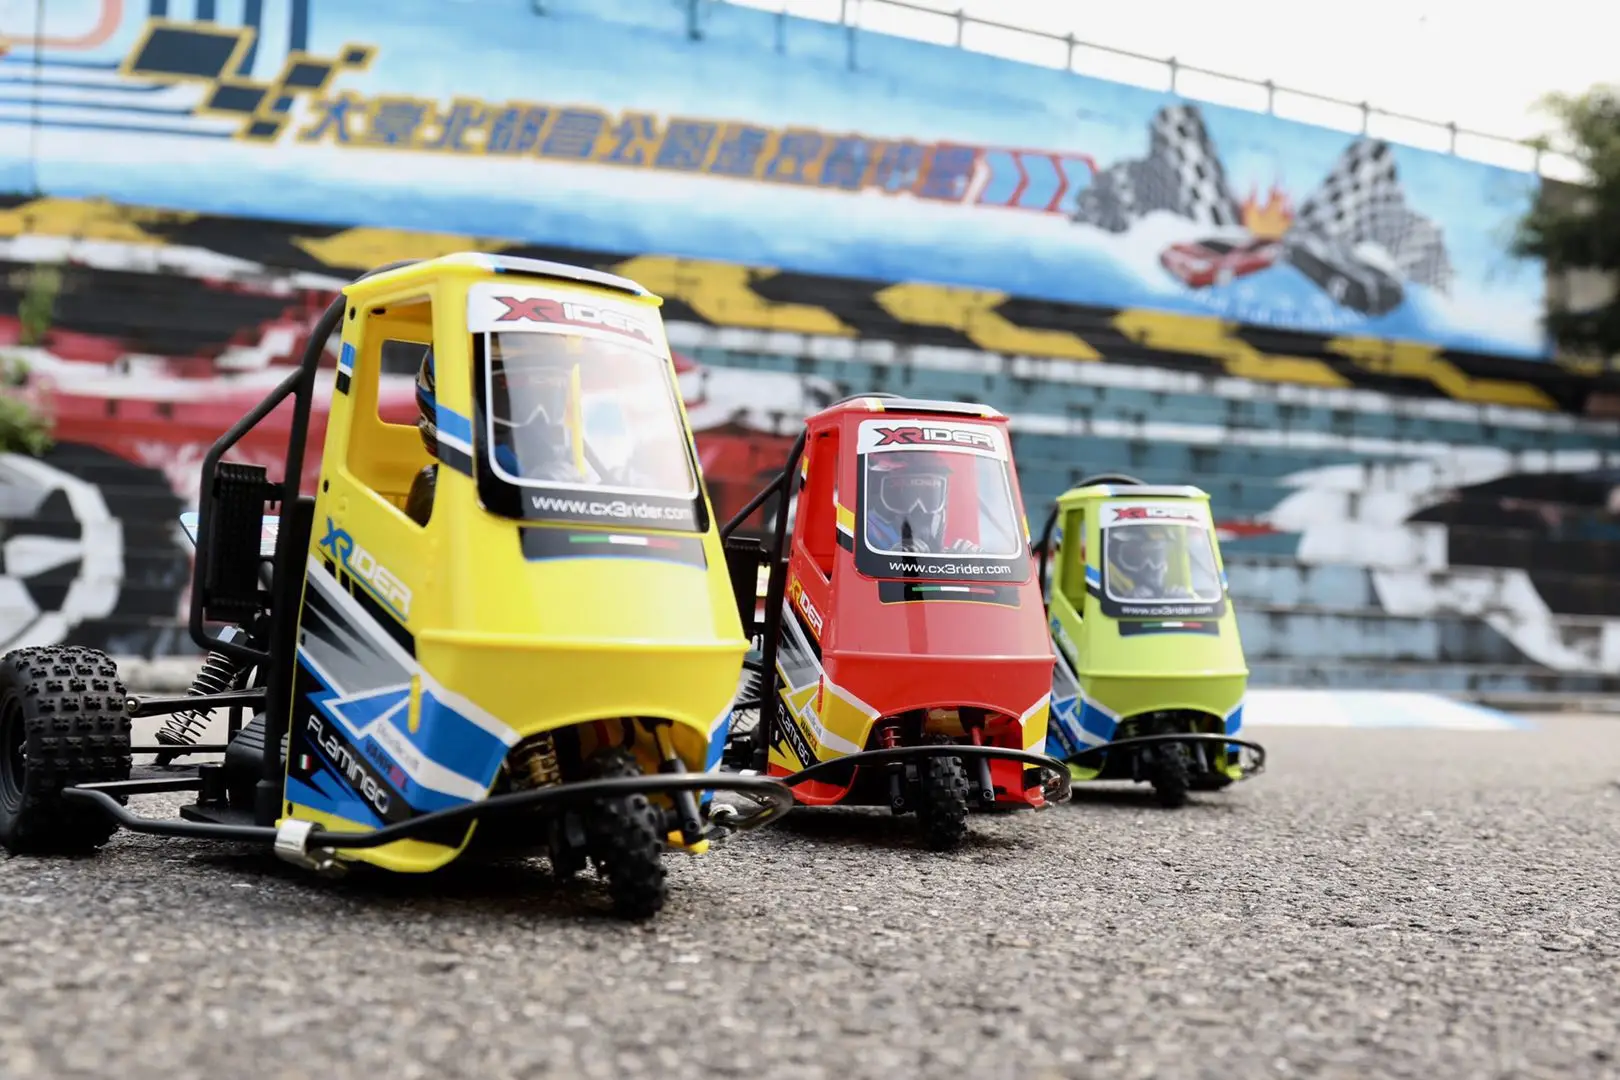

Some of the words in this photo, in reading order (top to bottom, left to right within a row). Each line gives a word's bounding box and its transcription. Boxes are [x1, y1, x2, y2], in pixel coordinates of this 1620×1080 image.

[873, 427, 996, 452] XRIDER
[531, 495, 694, 520] www.cx3rider.com
[888, 561, 1012, 575] www.cx3rider.com
